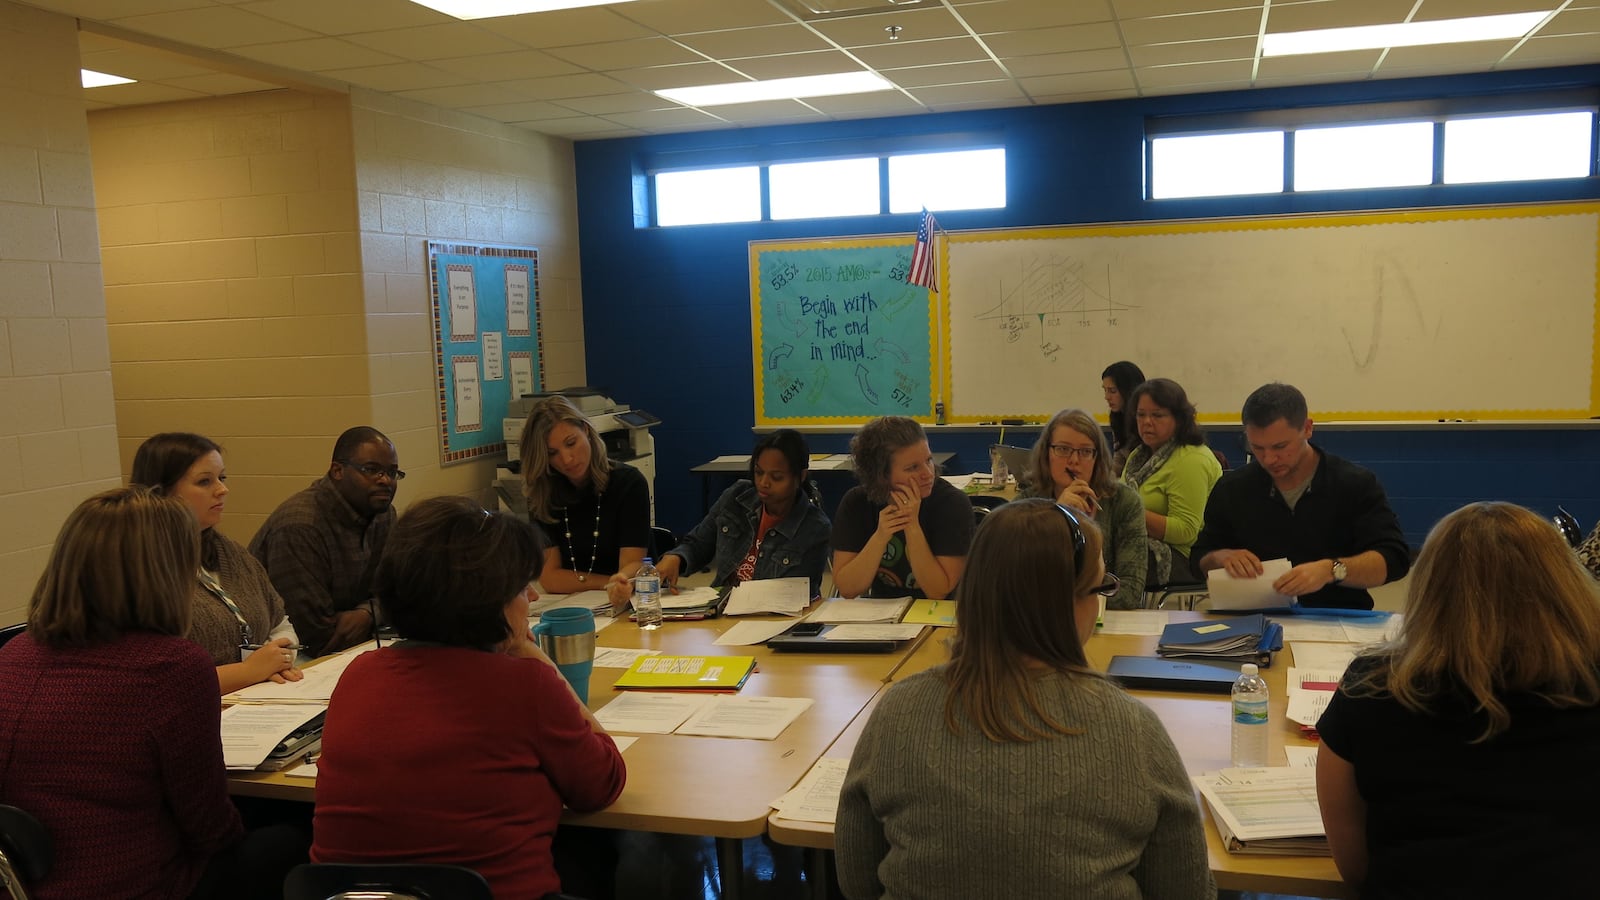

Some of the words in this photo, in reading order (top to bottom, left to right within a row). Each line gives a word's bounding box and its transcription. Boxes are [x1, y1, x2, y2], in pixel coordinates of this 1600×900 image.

[771, 263, 800, 291] 53.5%
[806, 268, 832, 283] 2015
[800, 295, 836, 318] Begin
[844, 291, 878, 313] with
[815, 319, 837, 339] the
[845, 316, 869, 336] end
[810, 343, 823, 361] in
[780, 377, 804, 404] 63.4%
[891, 388, 913, 408] 57%
